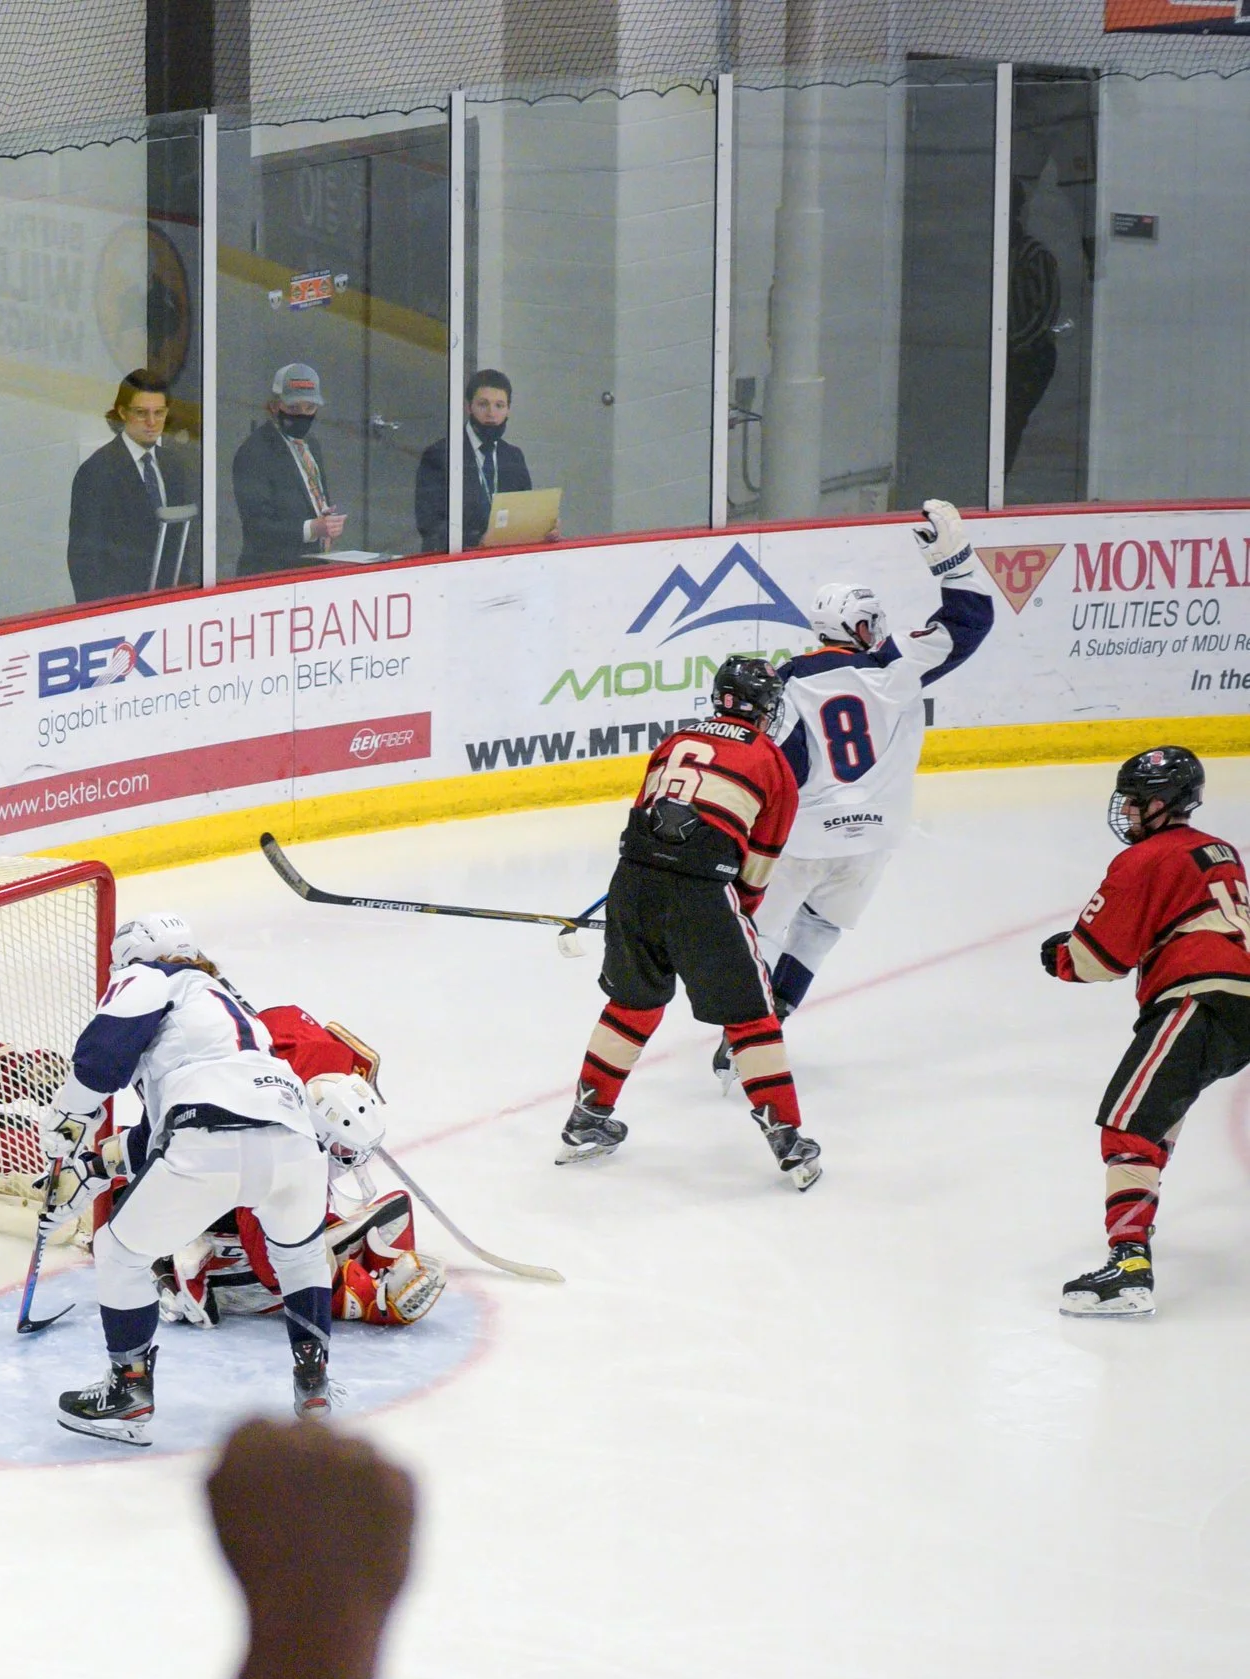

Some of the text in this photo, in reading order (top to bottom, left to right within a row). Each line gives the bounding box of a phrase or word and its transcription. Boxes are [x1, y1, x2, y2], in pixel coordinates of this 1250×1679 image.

[1072, 598, 1221, 631] UTILITIES CO.
[38, 592, 412, 698] BEK LIGHTBAND
[1069, 639, 1081, 657] A
[1086, 637, 1168, 658] Subsidiary
[1171, 635, 1189, 653] of
[1192, 634, 1231, 652] MDU
[38, 654, 411, 747] gigabit internet only on BEK Fiber
[1191, 668, 1250, 691] In the
[819, 694, 877, 784] 8
[653, 739, 717, 804] 6
[823, 813, 883, 829] SCHWAN
